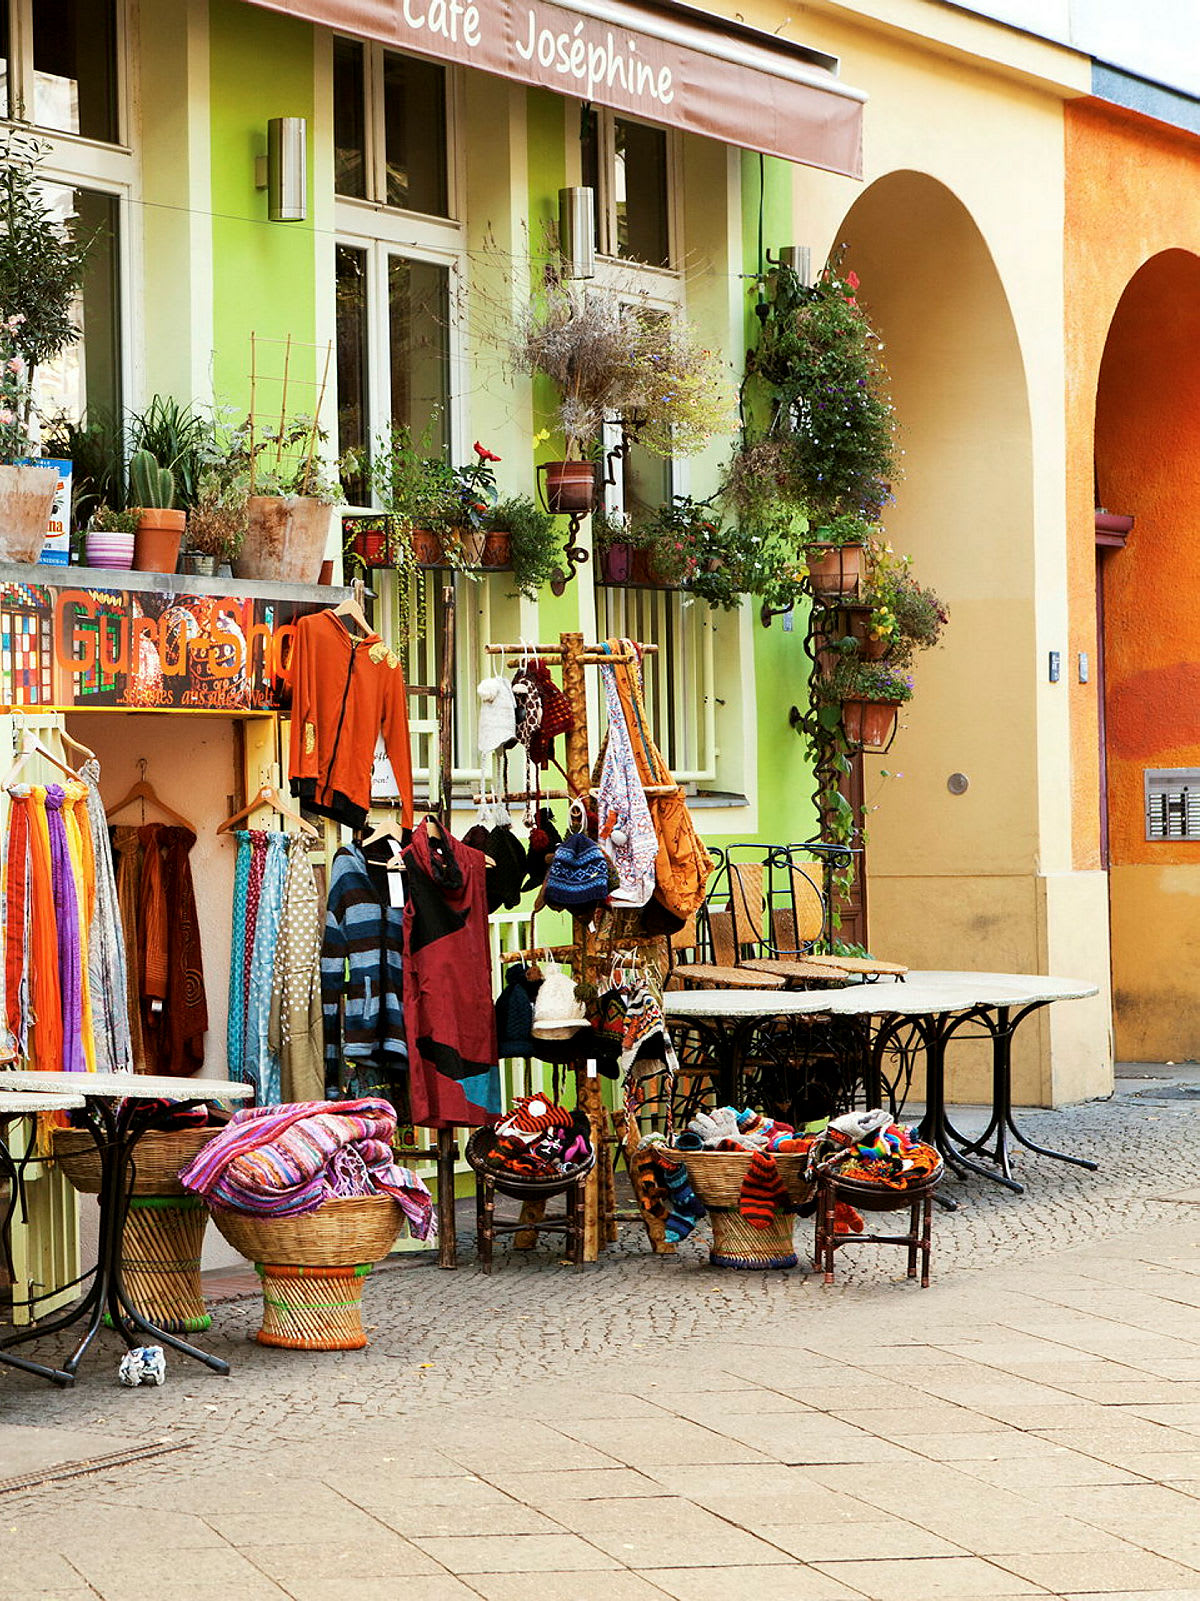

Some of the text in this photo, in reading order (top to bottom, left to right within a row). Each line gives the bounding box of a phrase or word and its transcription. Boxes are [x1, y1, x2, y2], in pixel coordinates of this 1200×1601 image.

[402, 0, 674, 104] Café Joséphine
[56, 590, 299, 681] Guru-Sho
